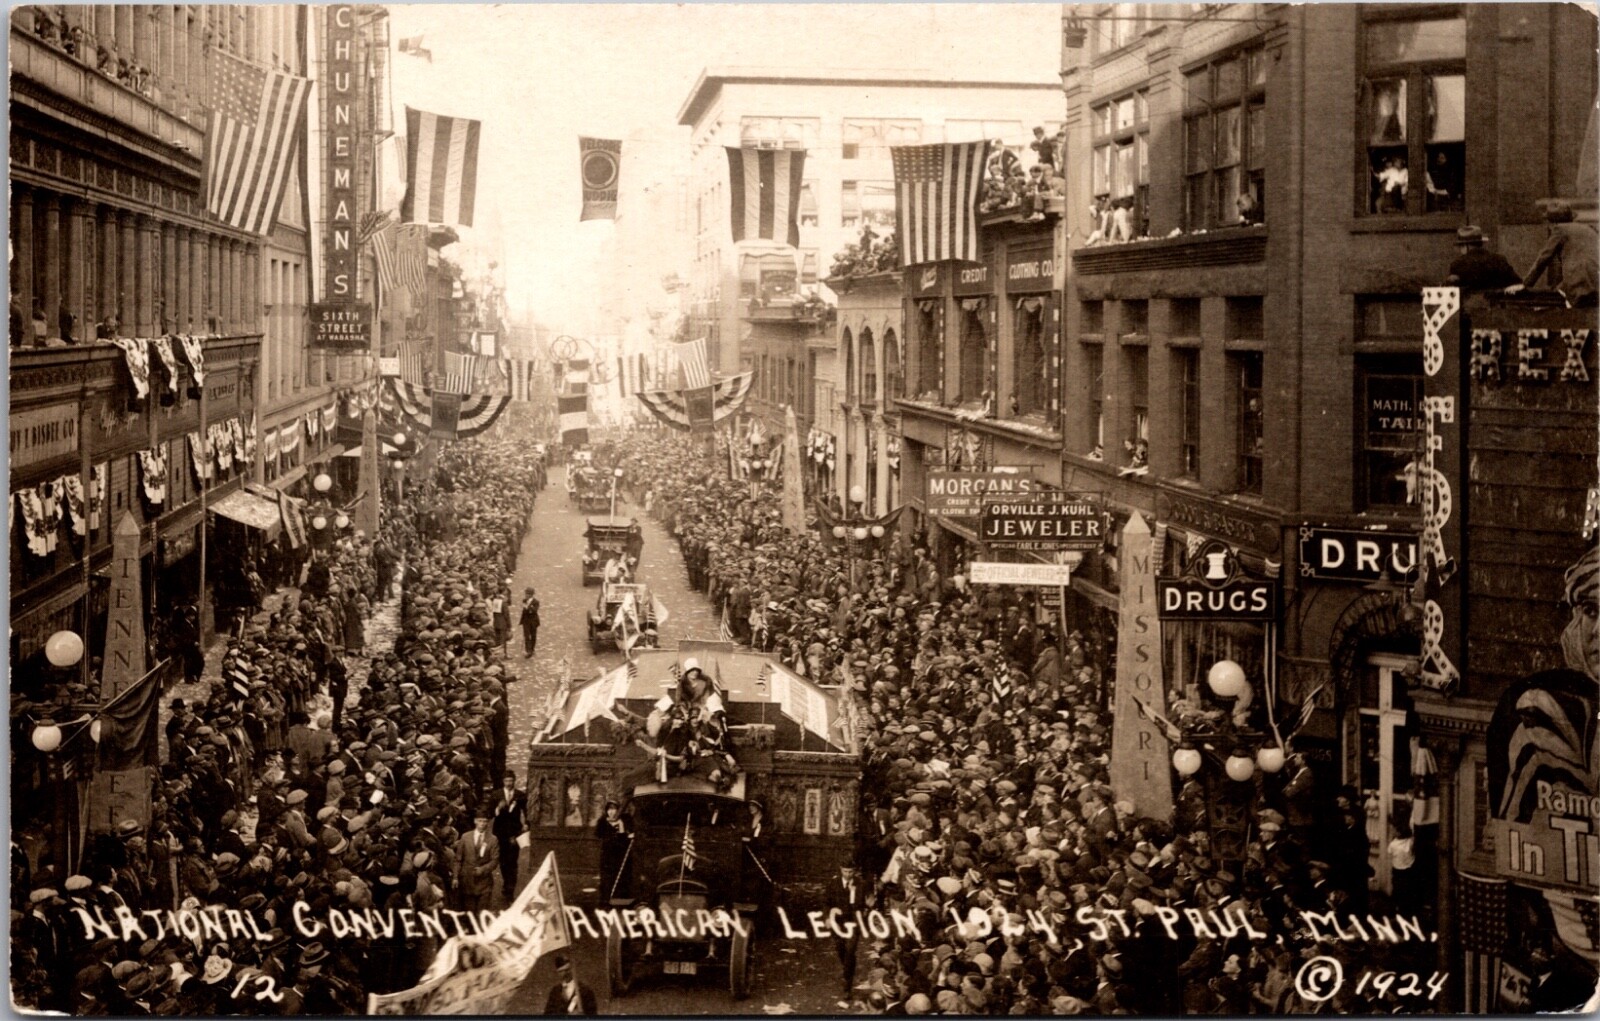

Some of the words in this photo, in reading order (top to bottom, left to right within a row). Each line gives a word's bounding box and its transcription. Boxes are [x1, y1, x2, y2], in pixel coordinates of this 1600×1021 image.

[961, 266, 988, 284] CREDIT
[1009, 260, 1039, 280] CLOTHING
[322, 311, 360, 321] SIXTH
[317, 333, 326, 341] AT
[328, 333, 365, 341] WABASHA
[319, 323, 363, 334] STREET
[1470, 328, 1589, 382] REX
[1373, 399, 1412, 411] MATH.
[930, 477, 1031, 496] MORGAN'S
[947, 498, 971, 506] CREDIT
[992, 504, 1045, 516] ORVILLE
[1048, 504, 1059, 516] J.
[1061, 504, 1095, 516] KUHL
[987, 519, 1100, 537] JEWELER
[1165, 586, 1268, 613] DRUGS
[1132, 554, 1152, 782] MISSOURI
[108, 557, 138, 827] TENNEEE
[1509, 829, 1544, 876] In
